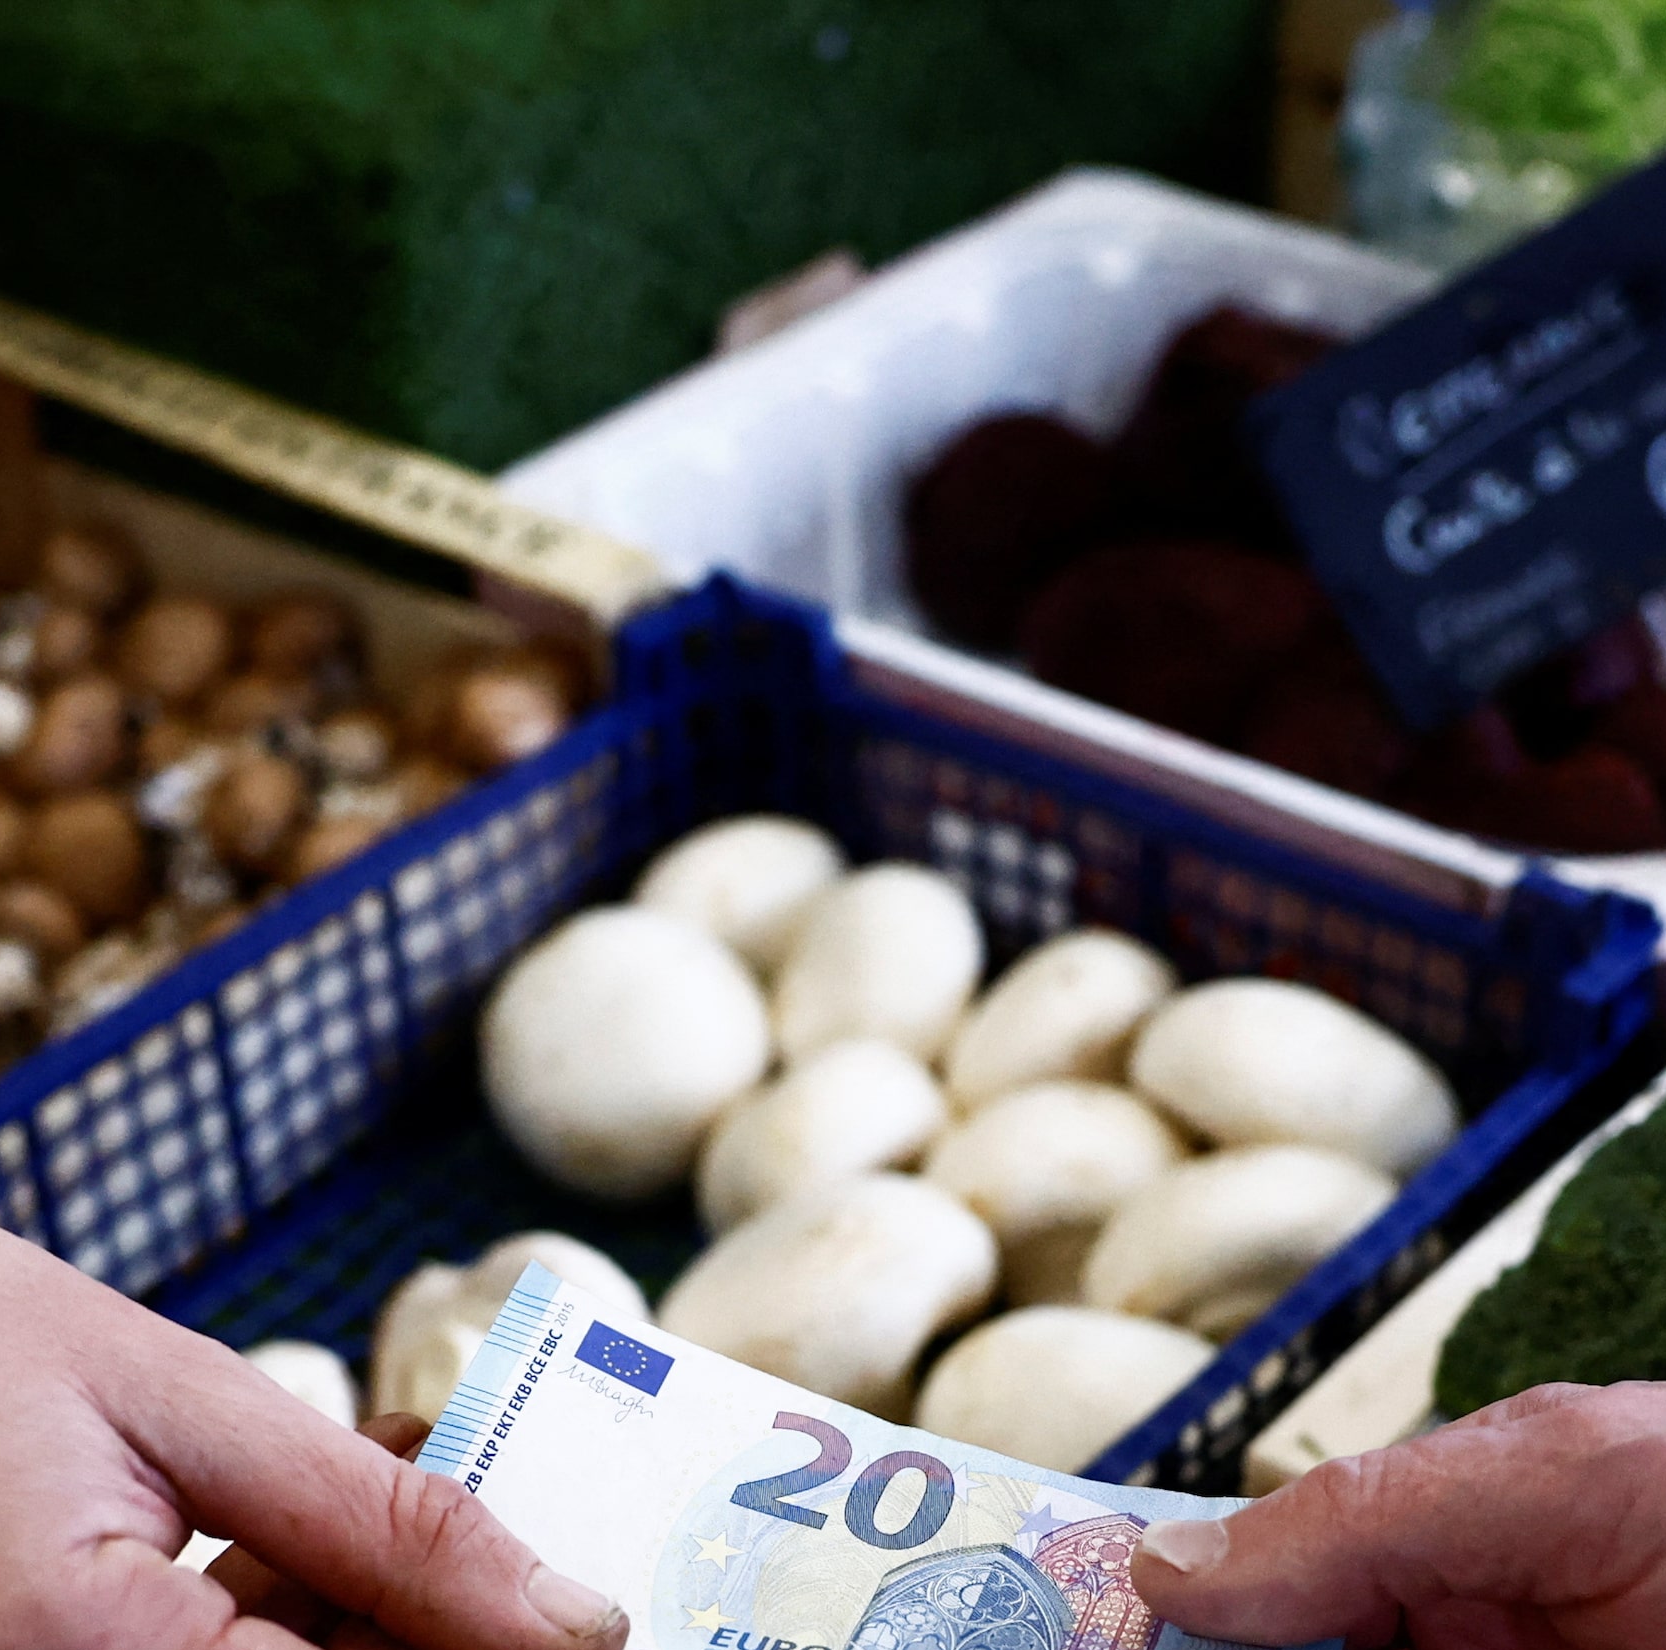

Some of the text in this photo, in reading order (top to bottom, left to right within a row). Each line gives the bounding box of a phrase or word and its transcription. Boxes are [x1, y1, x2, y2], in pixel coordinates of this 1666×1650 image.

[463, 1471, 483, 1495] ZB
[475, 1439, 500, 1472] EKP
[492, 1410, 517, 1440] EKT
[508, 1382, 533, 1412] EKB
[539, 1328, 563, 1358] EBC
[554, 1302, 575, 1327] 2015
[729, 1411, 955, 1550] 20
